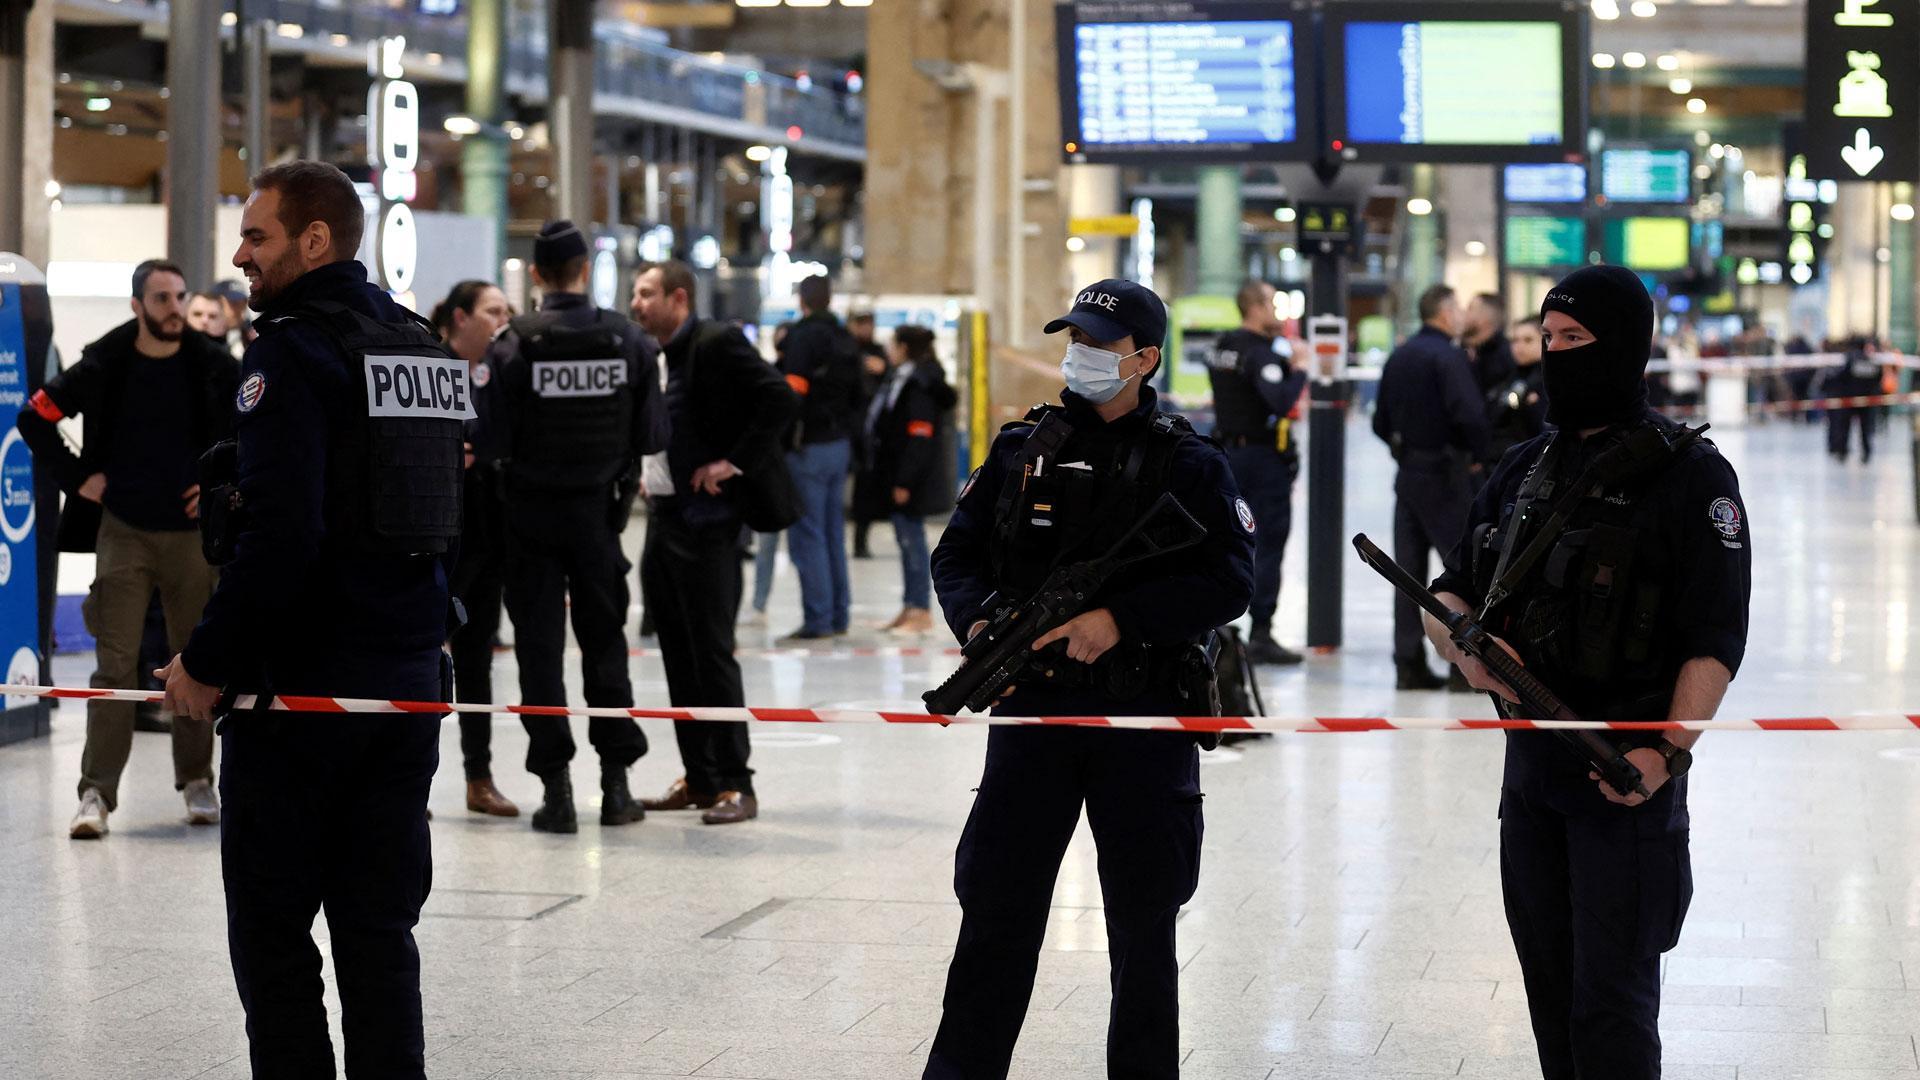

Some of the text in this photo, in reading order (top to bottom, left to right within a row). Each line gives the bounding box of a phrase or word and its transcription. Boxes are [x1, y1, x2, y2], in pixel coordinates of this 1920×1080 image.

[1075, 291, 1119, 312] POLICE
[1547, 293, 1575, 304] OLICE
[371, 364, 466, 411] POLICE
[540, 365, 621, 391] POLICE
